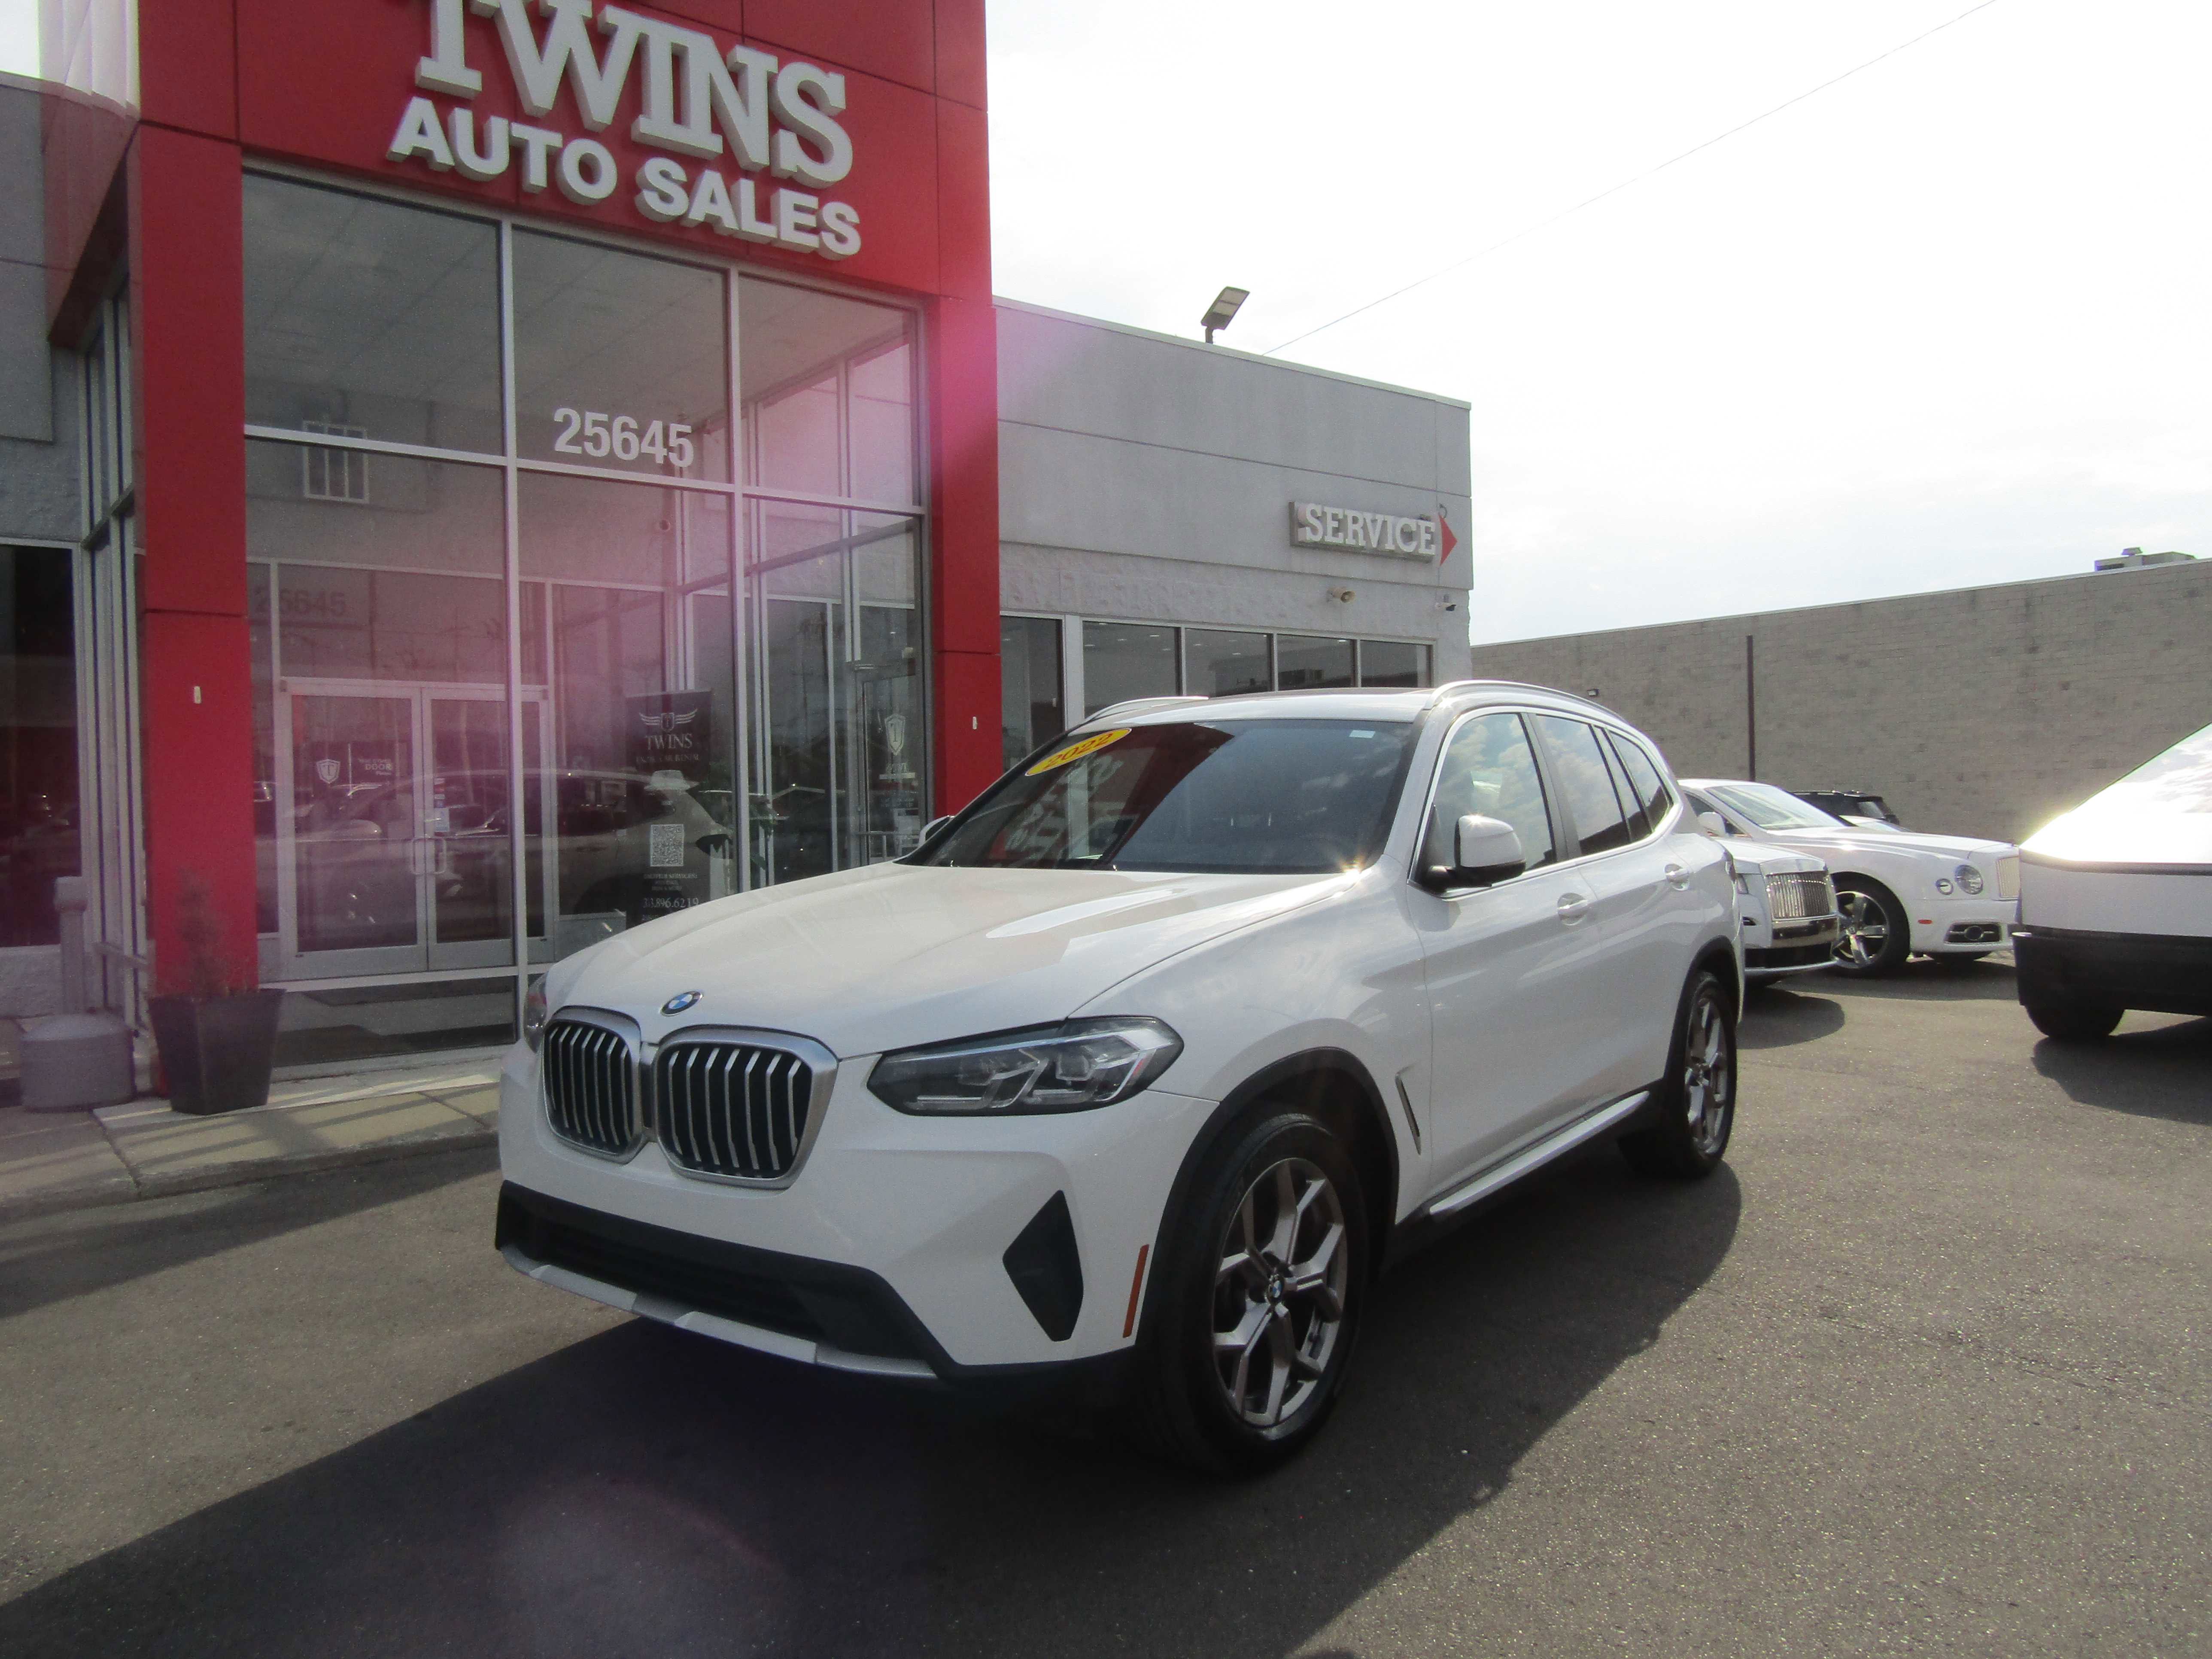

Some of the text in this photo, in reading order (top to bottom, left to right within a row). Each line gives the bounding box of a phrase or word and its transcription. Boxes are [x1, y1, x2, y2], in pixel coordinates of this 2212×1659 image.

[414, 0, 853, 189] TWINS
[386, 96, 862, 260] AUTO SALES
[553, 407, 694, 468] 25645
[1298, 502, 1436, 556] SERVICE
[644, 733, 693, 750] TWINS
[1043, 733, 1114, 770] 2022
